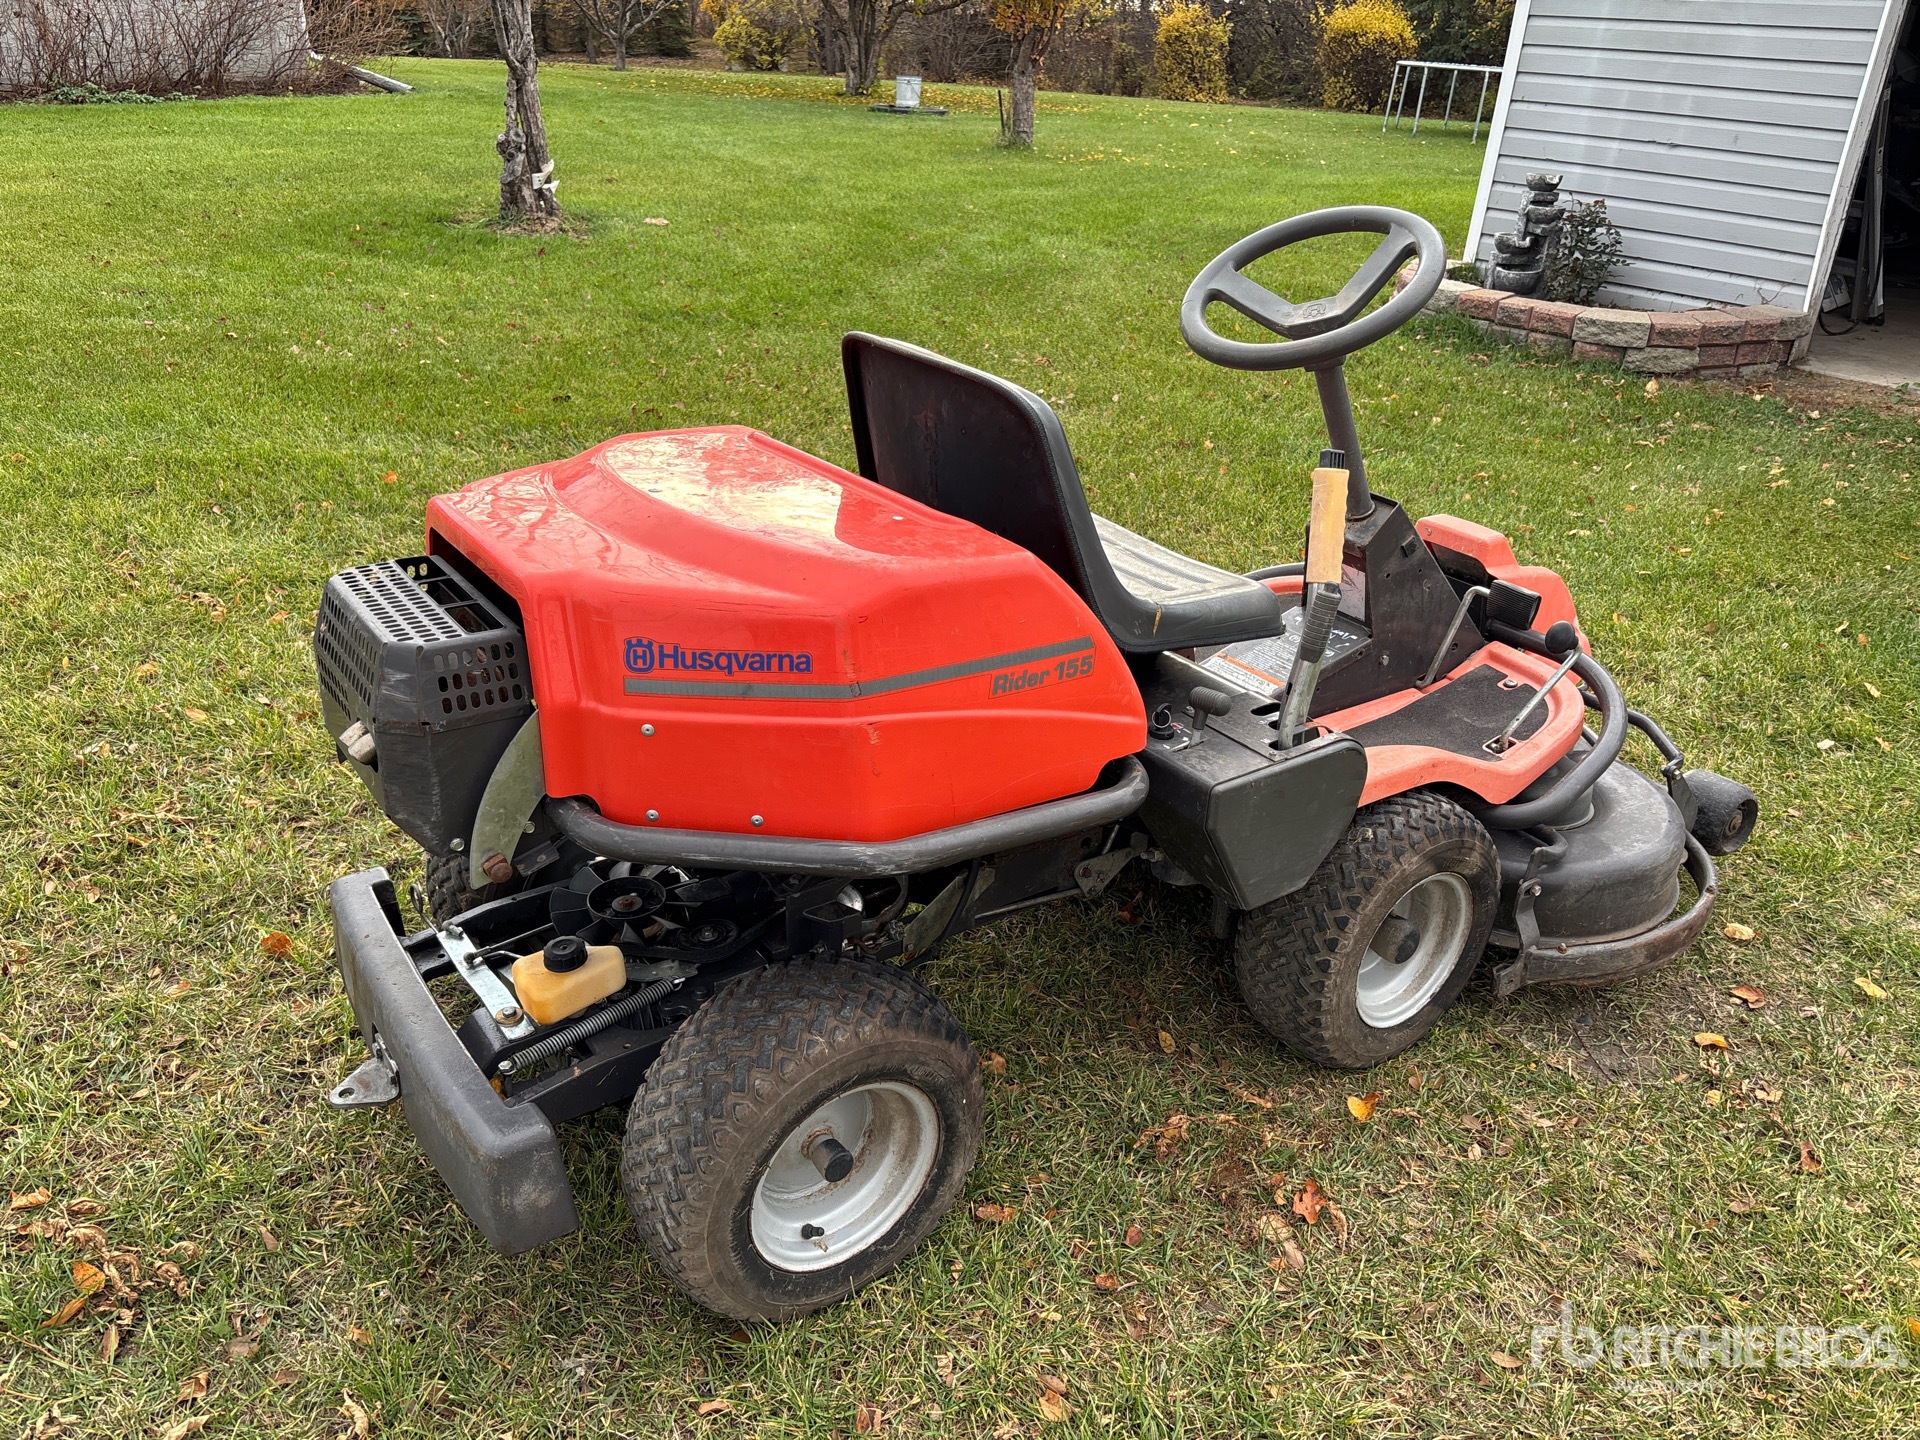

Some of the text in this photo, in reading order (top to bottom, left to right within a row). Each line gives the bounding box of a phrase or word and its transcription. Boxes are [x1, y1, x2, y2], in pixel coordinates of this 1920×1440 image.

[658, 644, 811, 675] Husqvarna
[991, 654, 1094, 696] Rider 155
